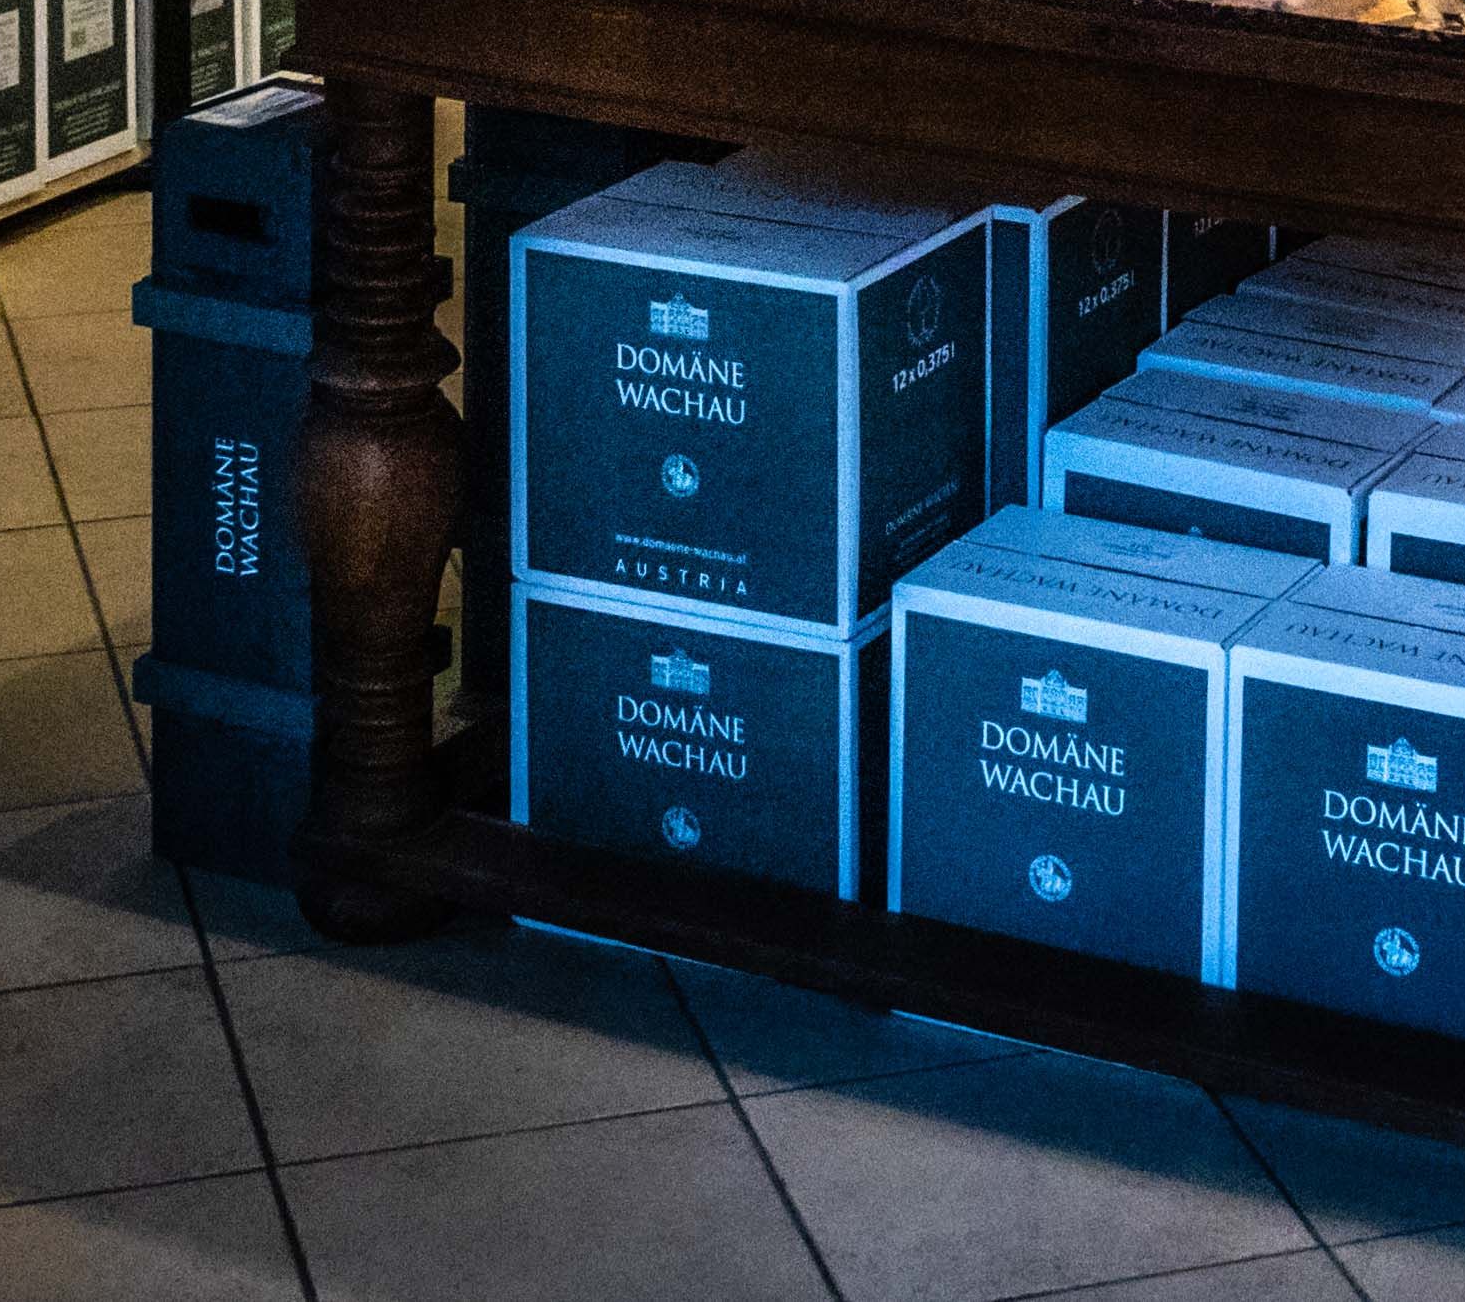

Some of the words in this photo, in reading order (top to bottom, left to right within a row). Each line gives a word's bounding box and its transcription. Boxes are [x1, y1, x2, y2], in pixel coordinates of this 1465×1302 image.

[616, 341, 746, 390] DOMÄNE
[892, 369, 907, 394] 12
[616, 379, 747, 426] WACHAU
[215, 436, 236, 575] DOMÄNE
[239, 441, 260, 578] WACHAU
[615, 558, 747, 596] AUSTRIA
[617, 694, 746, 744] DOMÄNE
[617, 730, 748, 780] WACHAU
[980, 719, 1126, 779] DOMÄNE
[980, 758, 1126, 817] WACHAU
